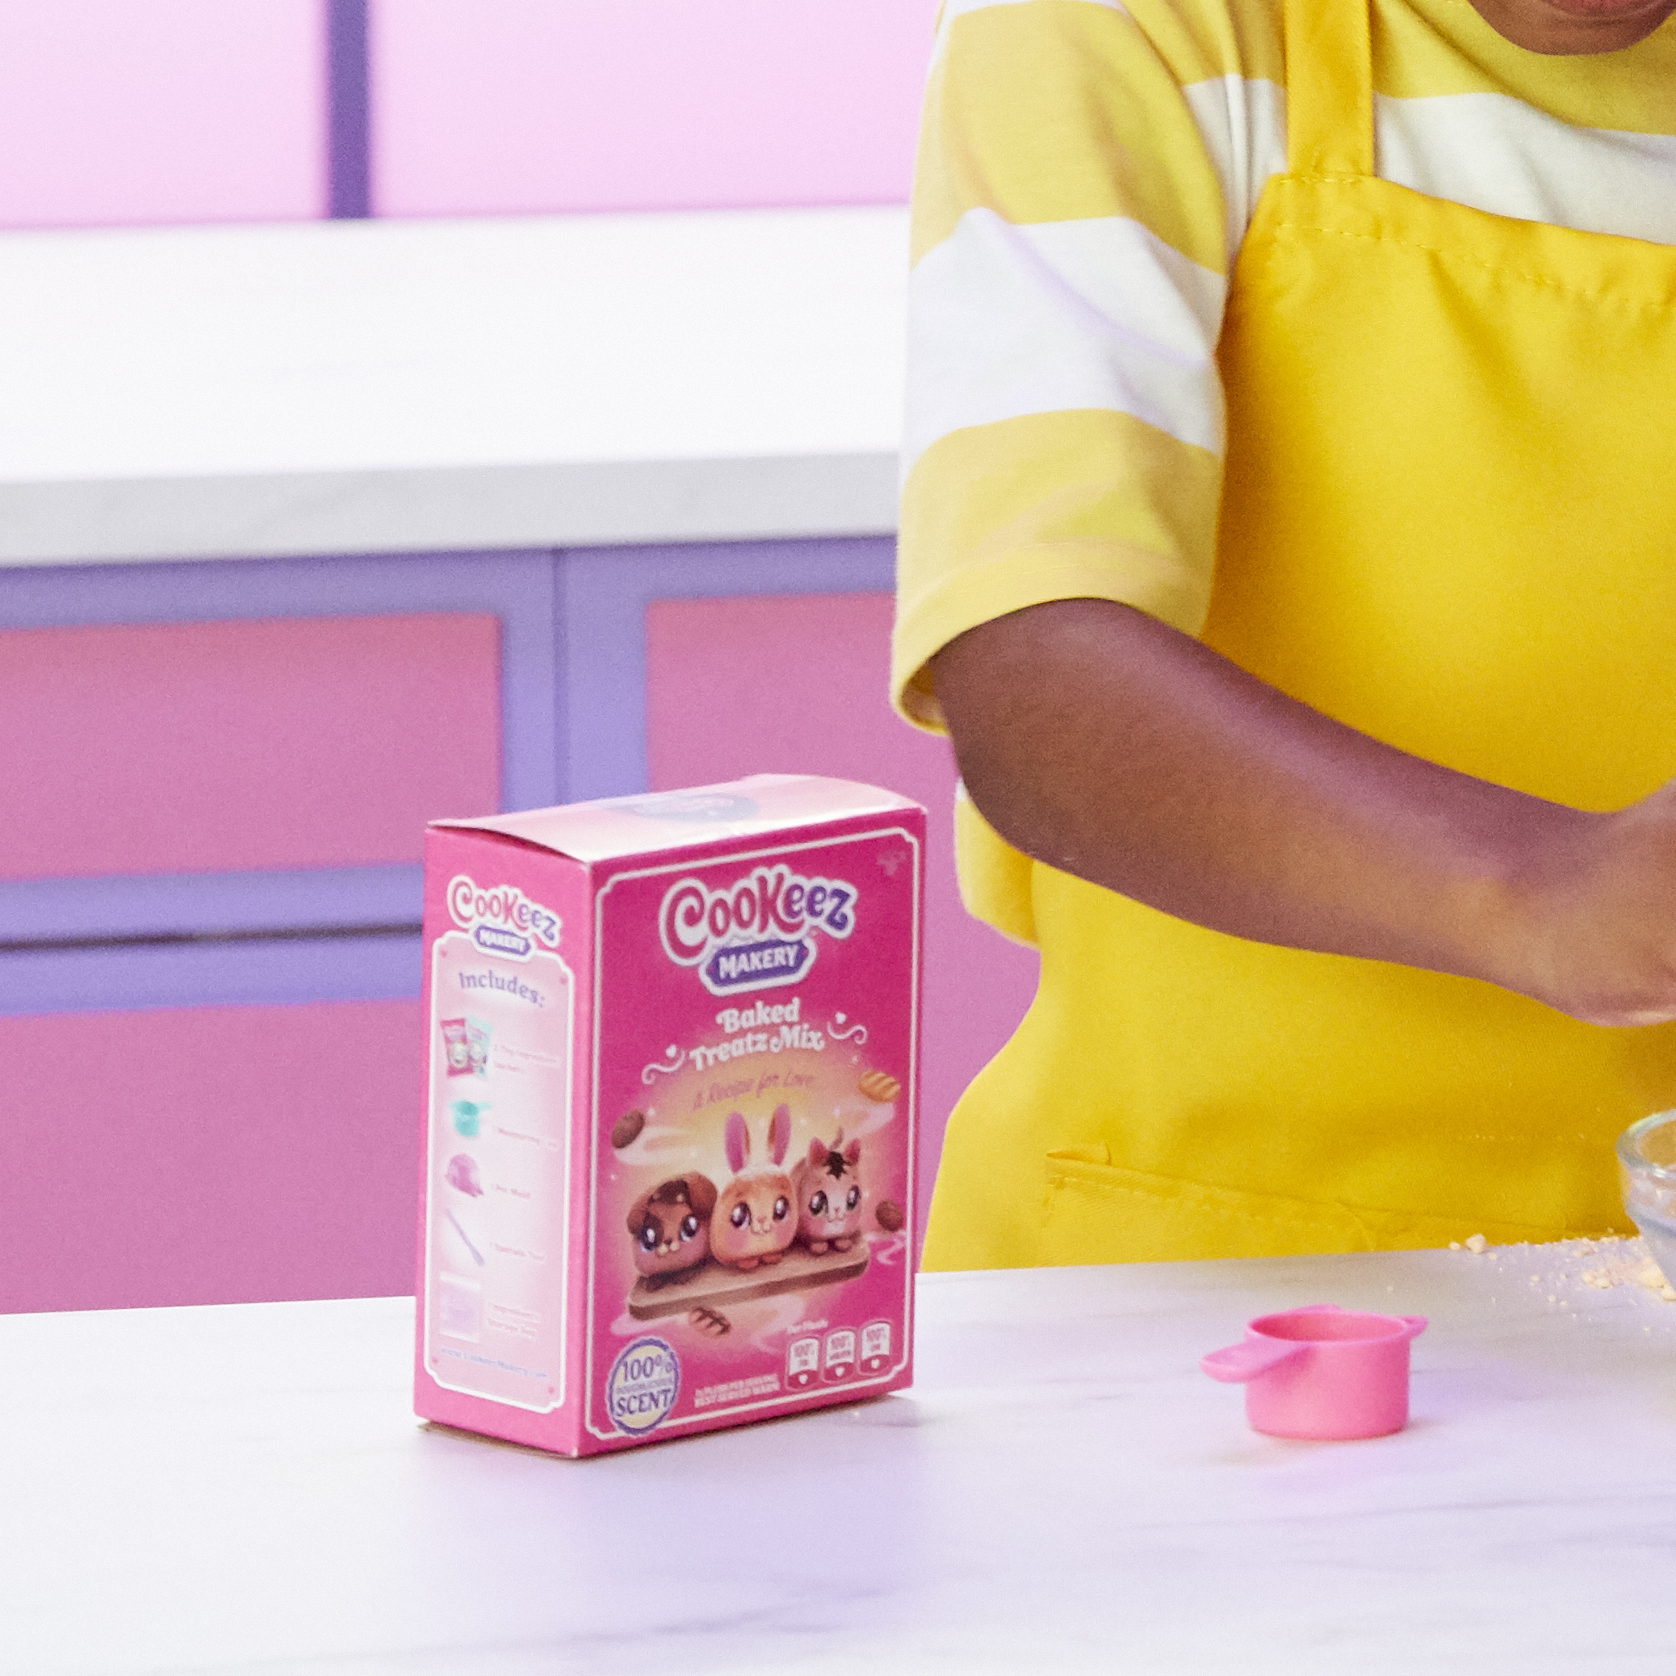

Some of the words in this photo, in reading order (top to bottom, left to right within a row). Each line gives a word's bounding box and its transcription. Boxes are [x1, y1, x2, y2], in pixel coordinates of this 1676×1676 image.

[718, 944, 801, 980] MAKERY
[715, 996, 801, 1034] Baked
[688, 1031, 768, 1071] Treatz
[769, 1023, 826, 1054] Mix
[623, 1354, 675, 1382] 100%
[615, 1388, 672, 1418] SCENT
